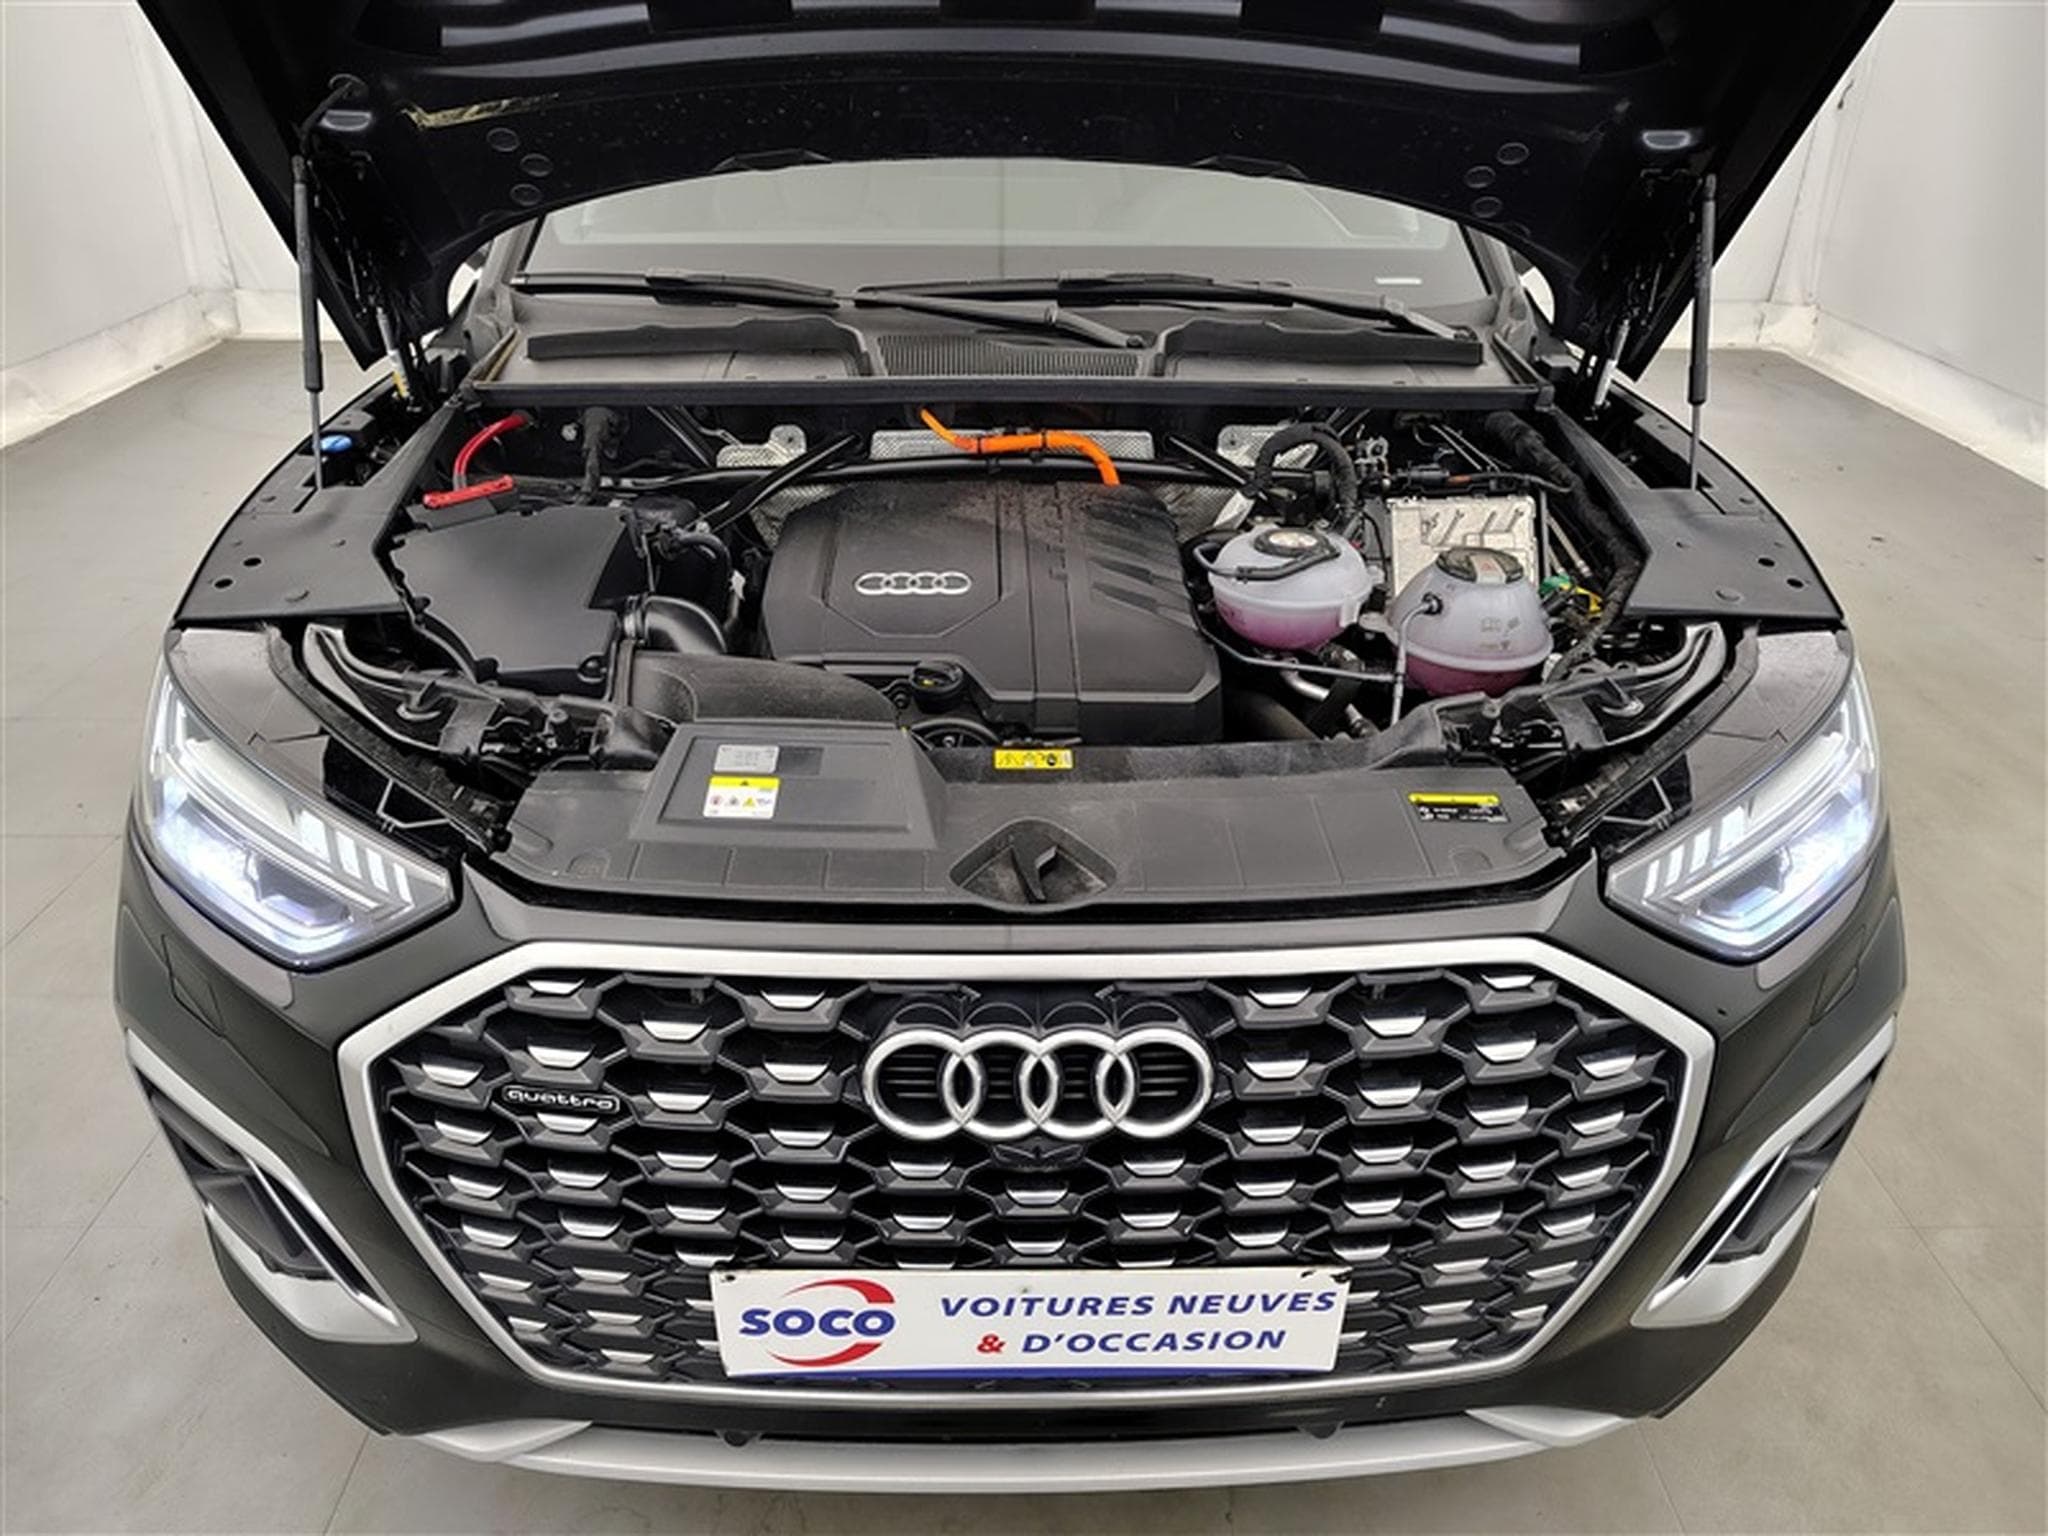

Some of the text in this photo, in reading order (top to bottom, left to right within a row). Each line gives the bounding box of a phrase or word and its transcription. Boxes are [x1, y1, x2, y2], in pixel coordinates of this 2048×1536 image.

[507, 1089, 614, 1108] quattro
[941, 1291, 1337, 1317] VOITURES NEUVES
[739, 1308, 895, 1337] SOCO
[975, 1329, 1286, 1354] & D'OCCASION
